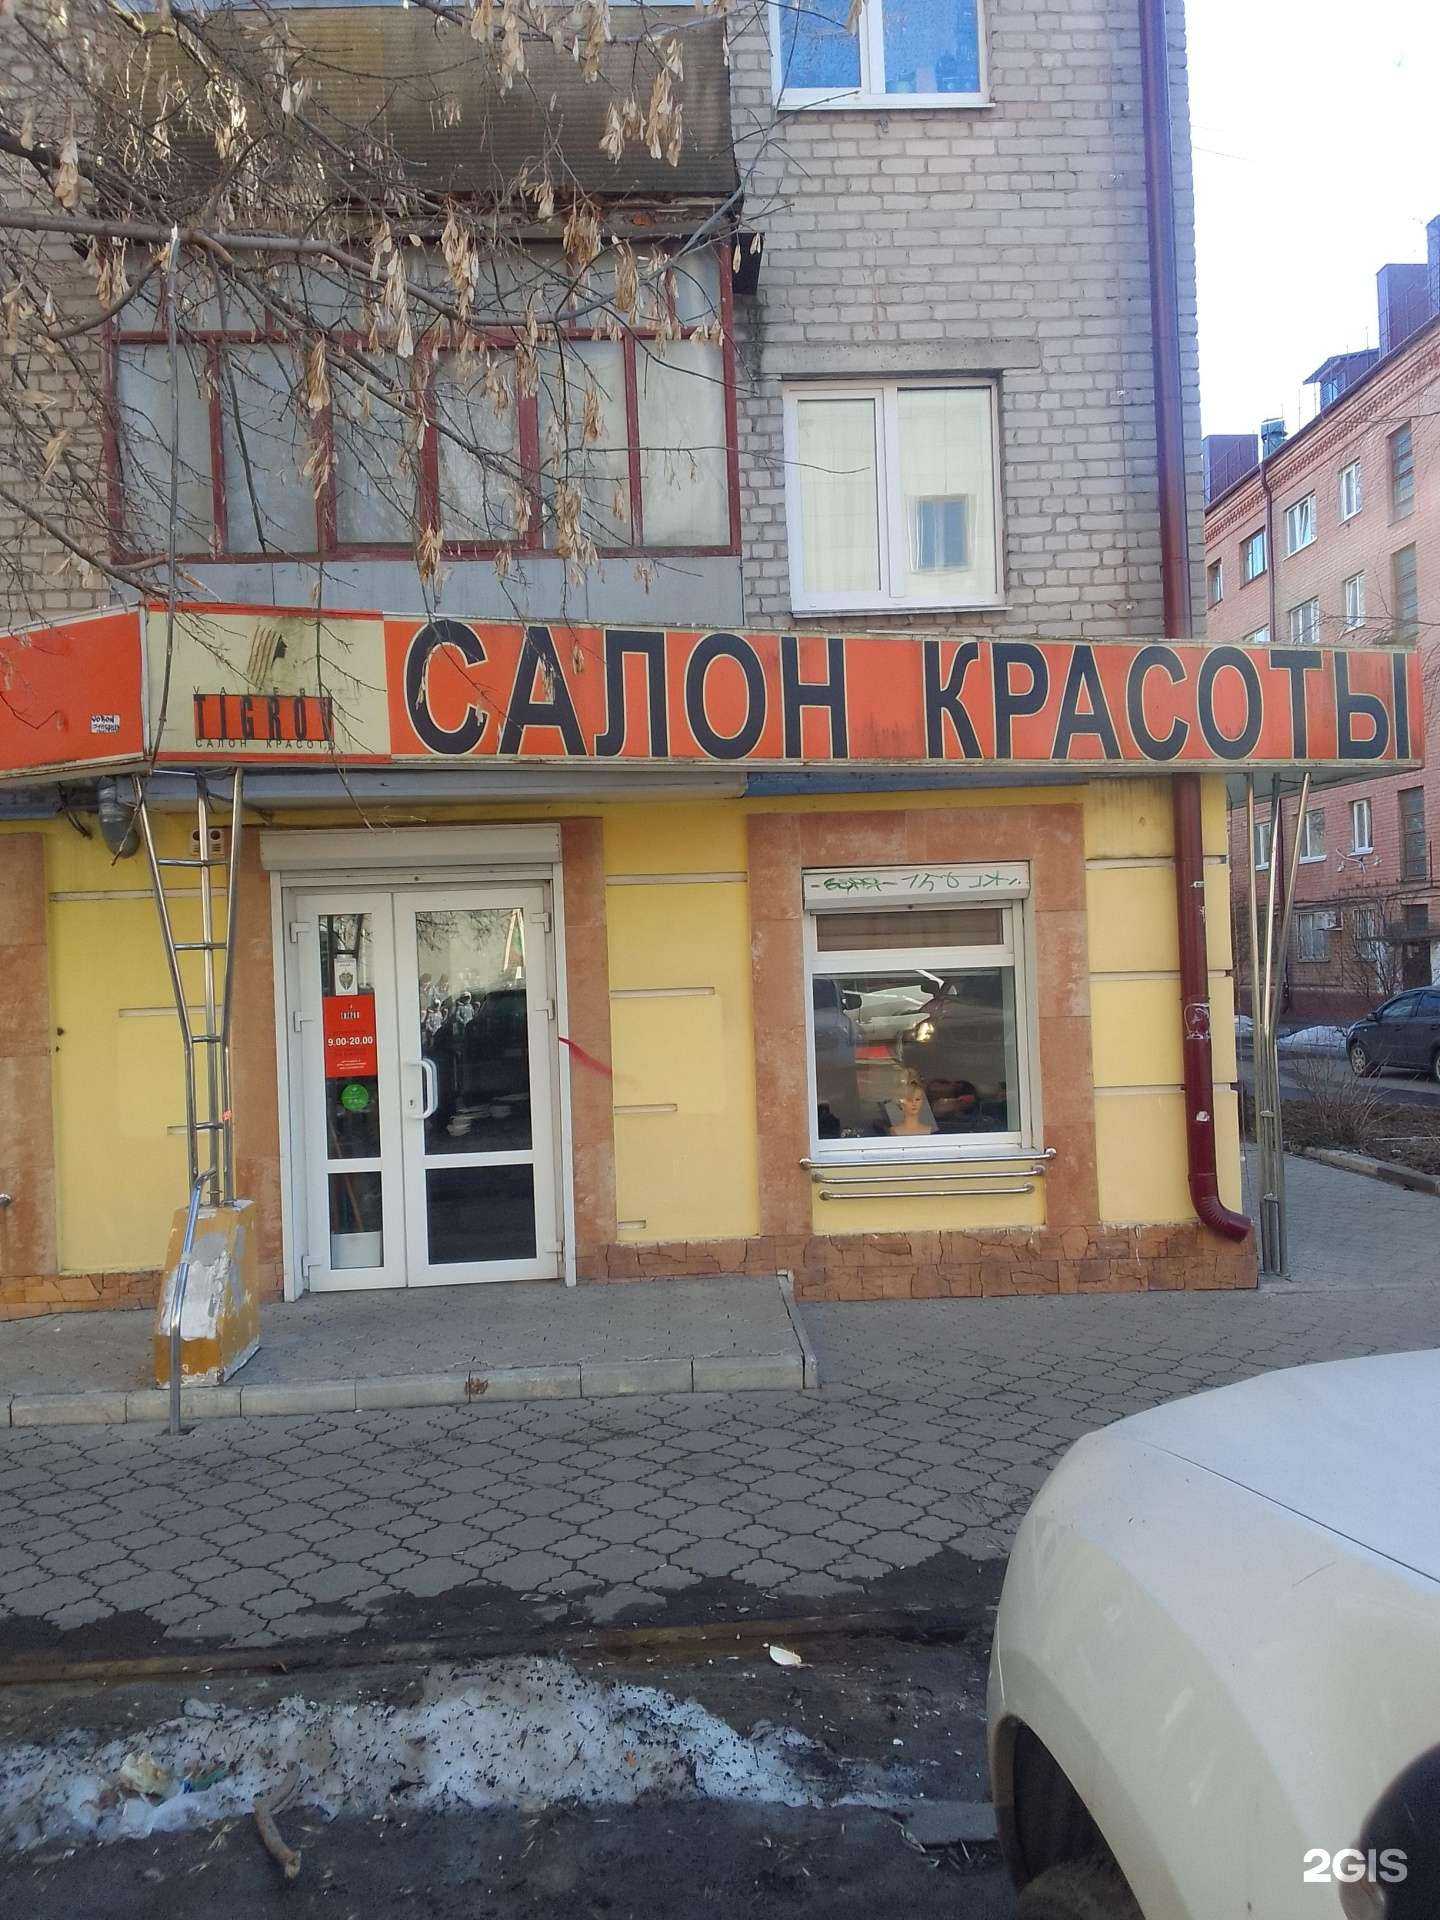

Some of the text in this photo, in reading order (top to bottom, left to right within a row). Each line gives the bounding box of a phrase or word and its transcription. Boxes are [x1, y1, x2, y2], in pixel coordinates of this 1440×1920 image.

[404, 619, 1412, 761] САЛОН КРАСОТЫ
[195, 739, 247, 748] САЛОН
